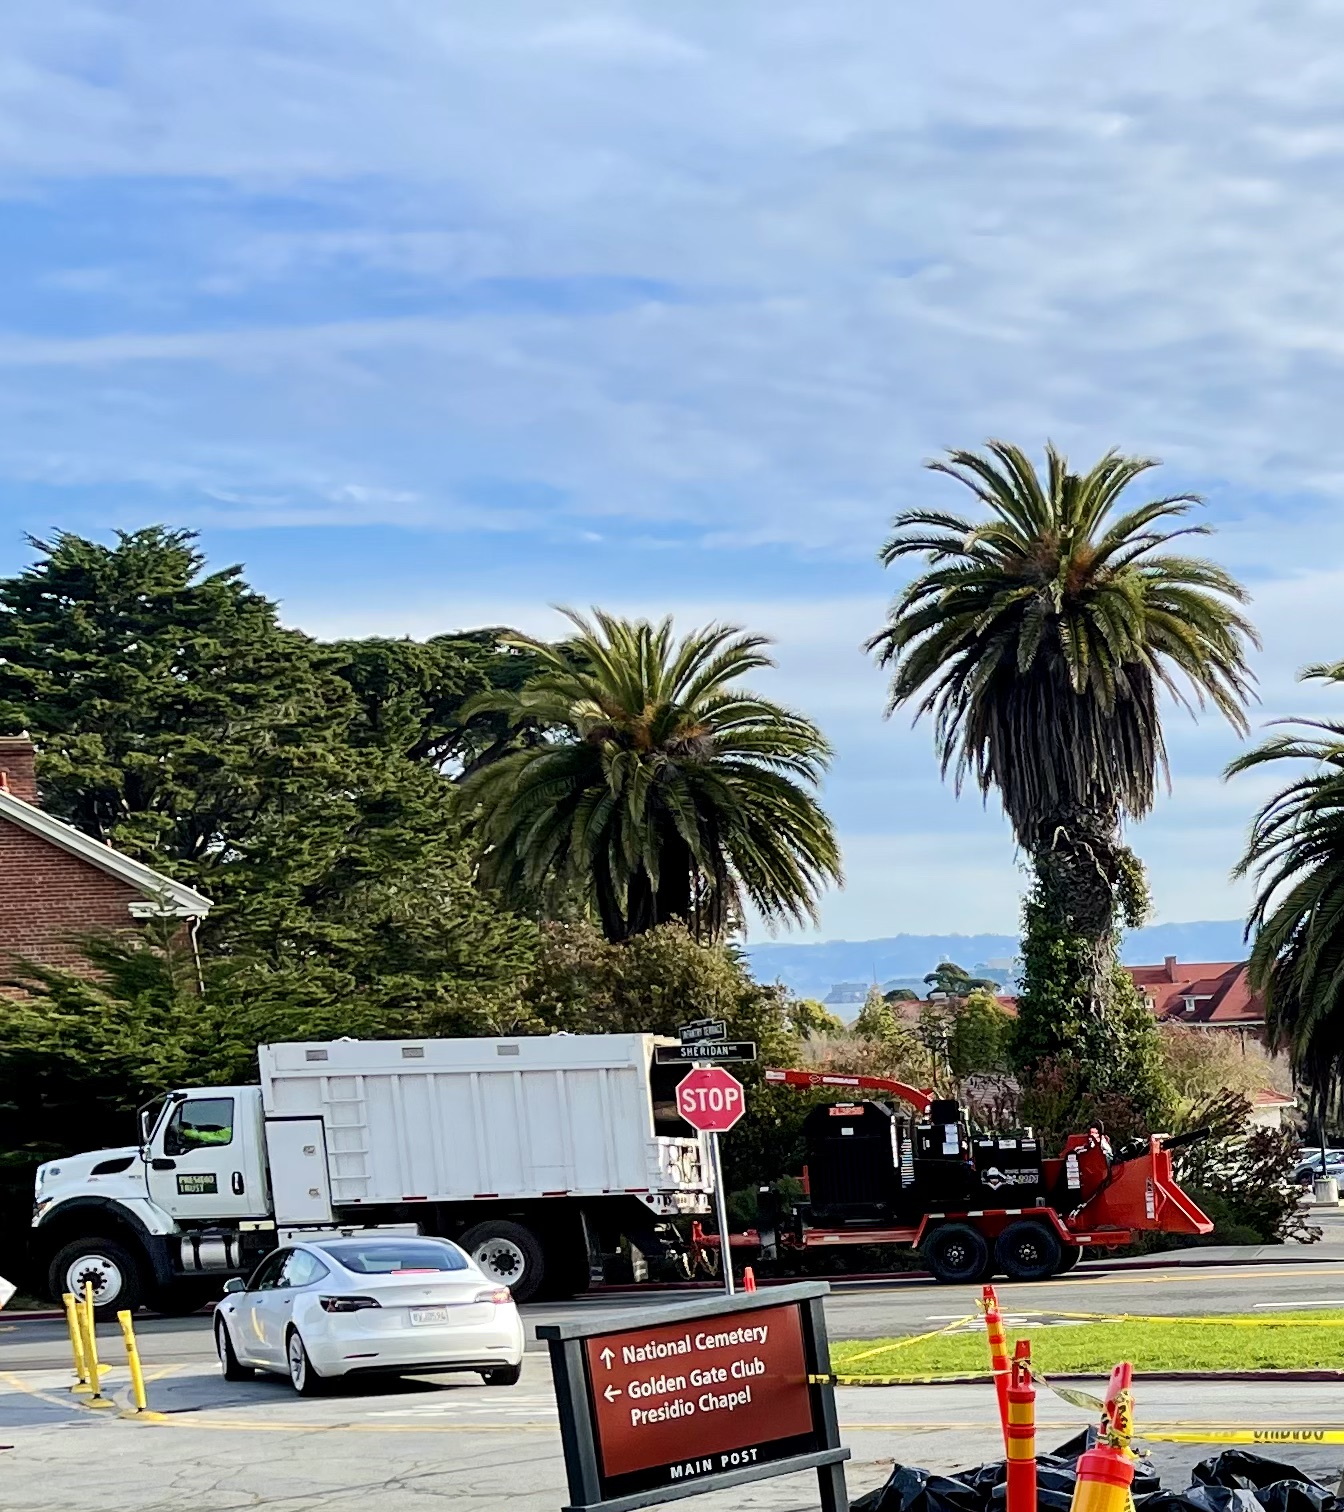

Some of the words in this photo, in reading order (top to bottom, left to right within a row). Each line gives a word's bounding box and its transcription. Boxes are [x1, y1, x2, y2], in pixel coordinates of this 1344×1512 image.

[680, 1045, 729, 1057] SHERIDAN
[682, 1088, 738, 1112] STOP
[622, 1334, 692, 1365] National
[695, 1324, 768, 1351] Cemetery
[627, 1373, 687, 1400] Golden
[690, 1367, 727, 1387] Gate
[731, 1357, 766, 1377] Club
[630, 1400, 695, 1427] Presidio
[698, 1386, 752, 1412] Chapel
[670, 1458, 712, 1479] MAIN
[721, 1448, 758, 1468] POST
